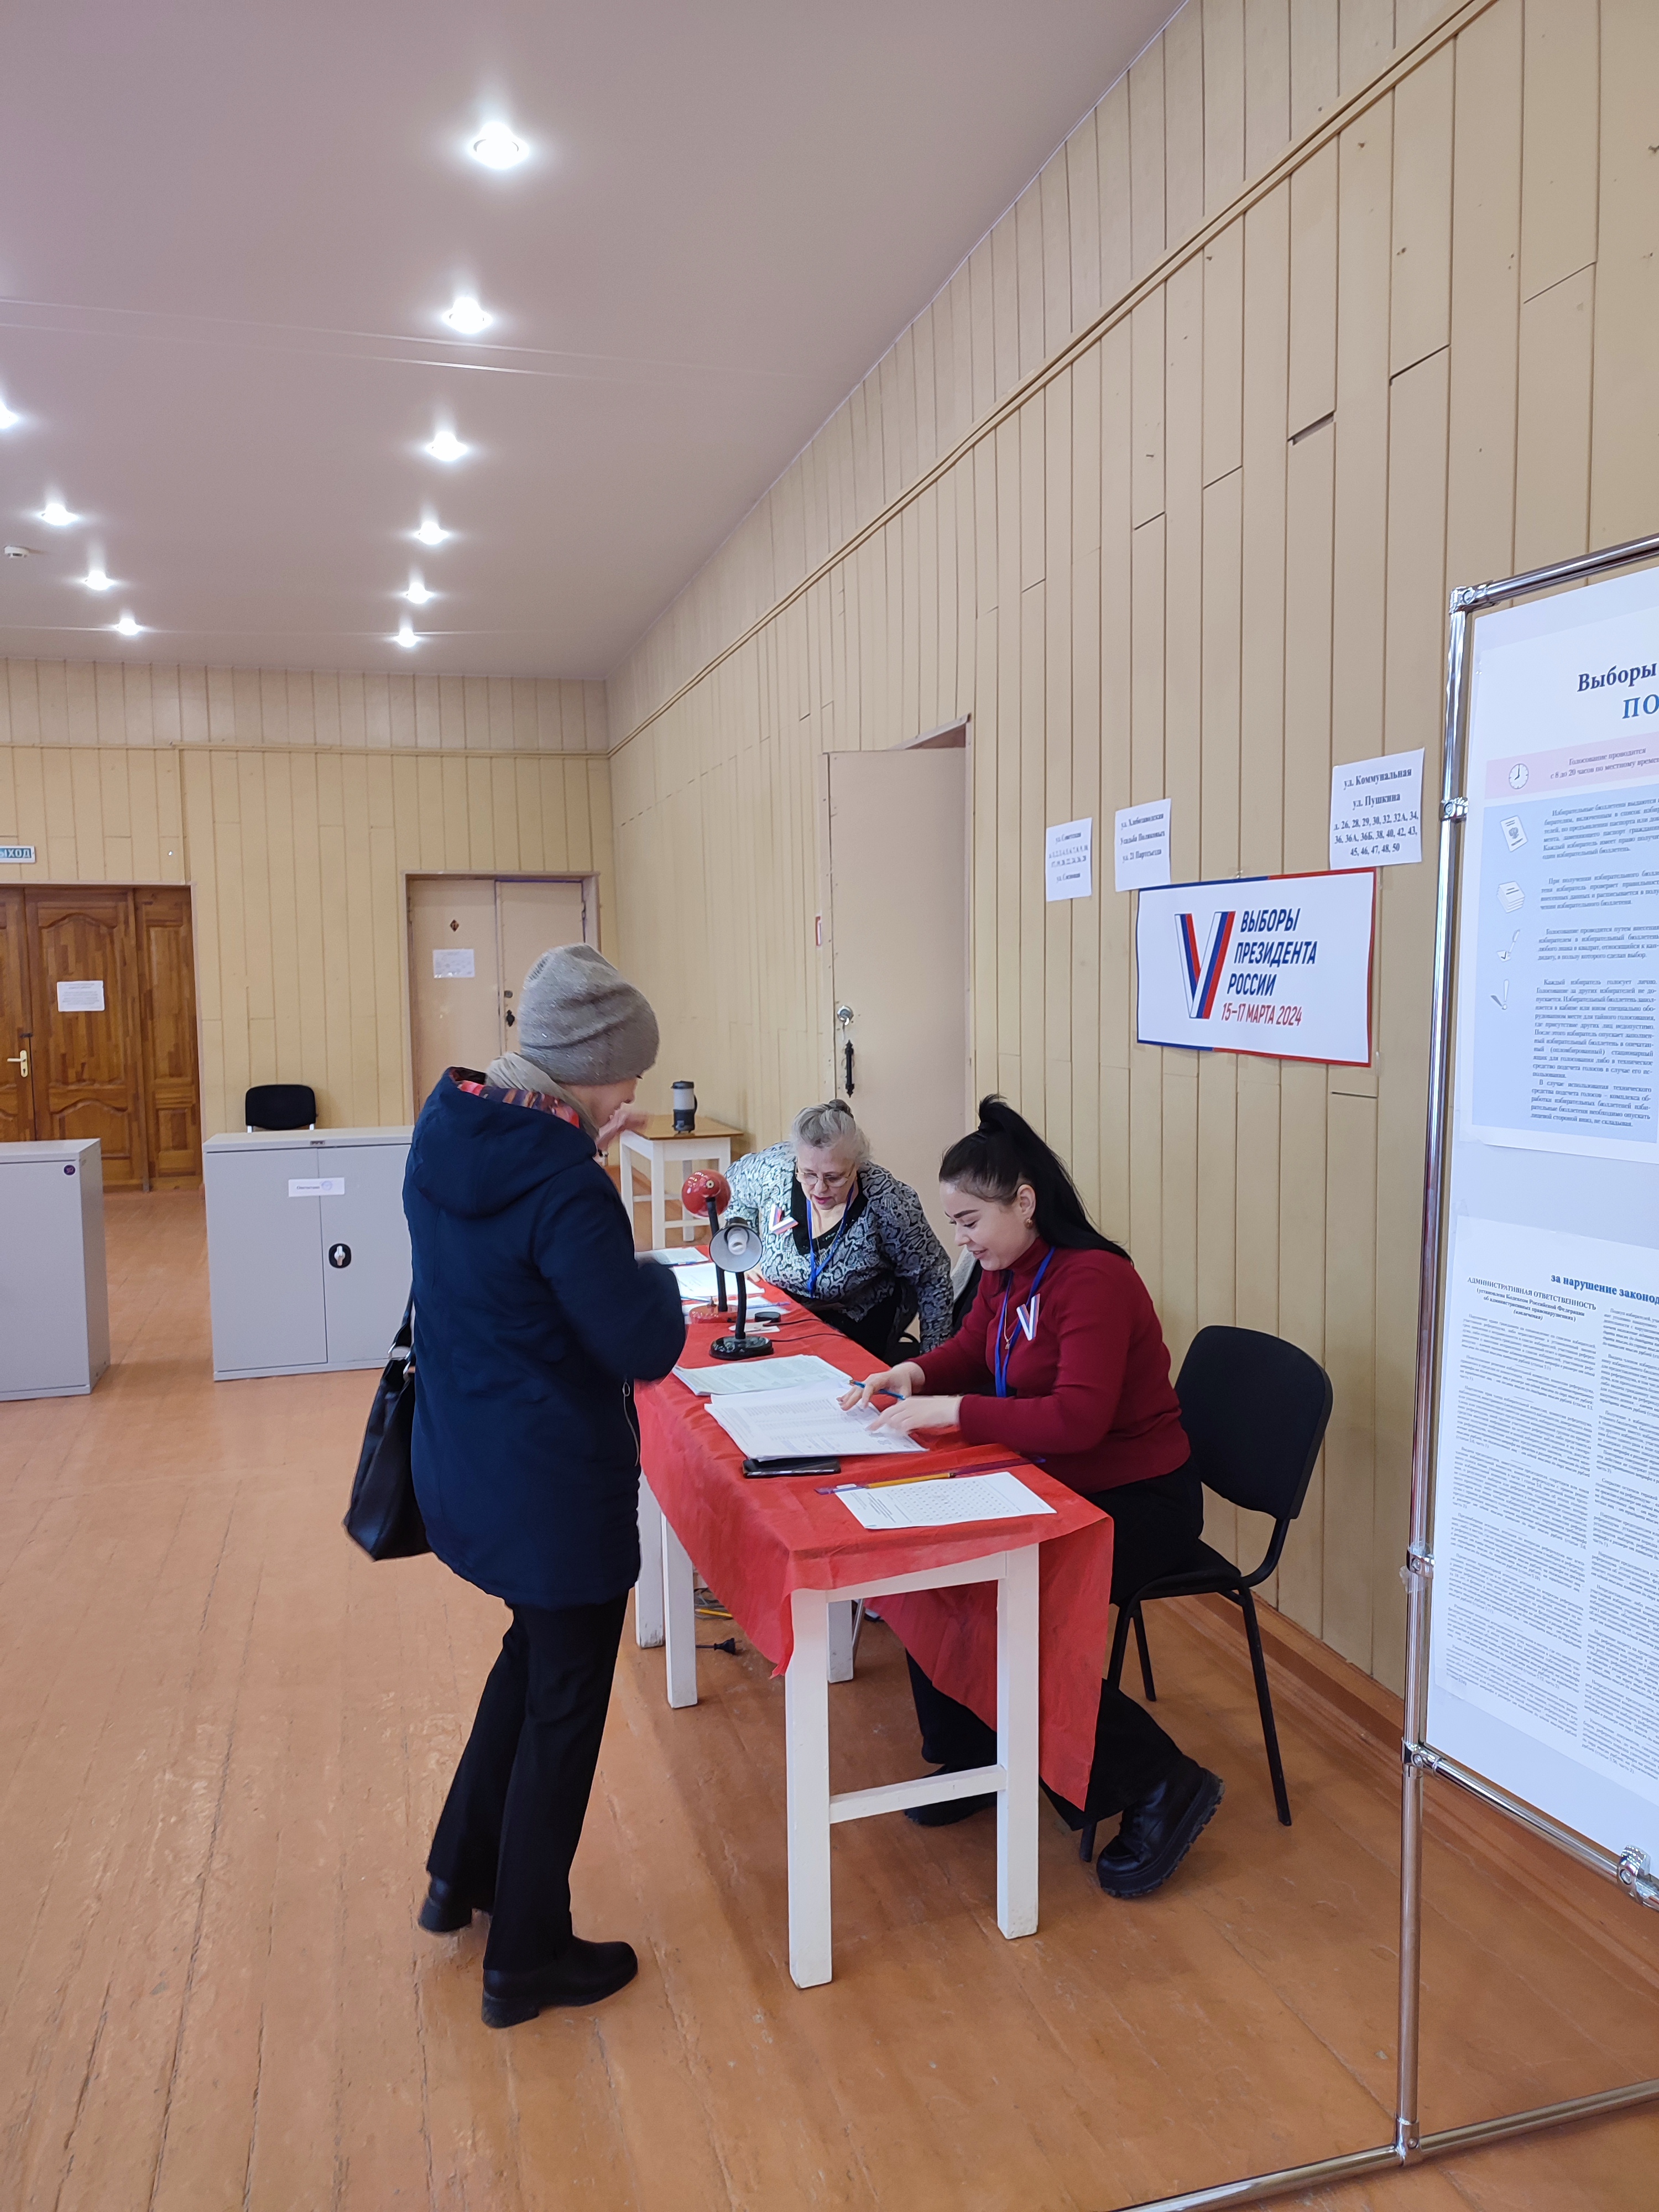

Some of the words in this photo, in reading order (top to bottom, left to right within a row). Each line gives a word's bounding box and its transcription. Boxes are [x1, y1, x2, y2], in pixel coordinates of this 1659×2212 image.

[1577, 662, 1657, 692] Выборы
[1621, 694, 1659, 719] ПО
[1343, 780, 1354, 790] ул.
[1355, 768, 1412, 786] Коммунальная
[1352, 800, 1363, 810] ул.
[1365, 794, 1400, 807] Пушкина
[1341, 820, 1350, 830] 26,
[1352, 819, 1361, 828] 28,
[1362, 817, 1371, 827] 29,
[1372, 816, 1381, 826] 30,
[1383, 814, 1392, 824] 32,
[1393, 812, 1408, 823] 32А,
[1410, 810, 1418, 821] 34,
[1334, 835, 1344, 844] 36,
[1360, 831, 1374, 841] 36Б,
[1386, 828, 1396, 838] 40,
[1350, 847, 1359, 856] 45,
[1360, 846, 1369, 855] 46,
[1371, 845, 1380, 854] 47,
[1381, 844, 1391, 853] 48,
[1392, 843, 1400, 852] 50
[1240, 907, 1301, 933] ВЫБОРЫ
[1233, 941, 1318, 968] ПРЕЗИДЕНТА
[1227, 973, 1277, 997] РОССИИ
[1245, 1004, 1276, 1025] МАРТА
[1275, 1005, 1302, 1026] 2024
[1551, 1274, 1561, 1284] за
[1563, 1276, 1618, 1295] нарушение
[1619, 1288, 1659, 1305] законод
[1533, 1291, 1597, 1311] ОТВЕТСТВЕННОСТЬ
